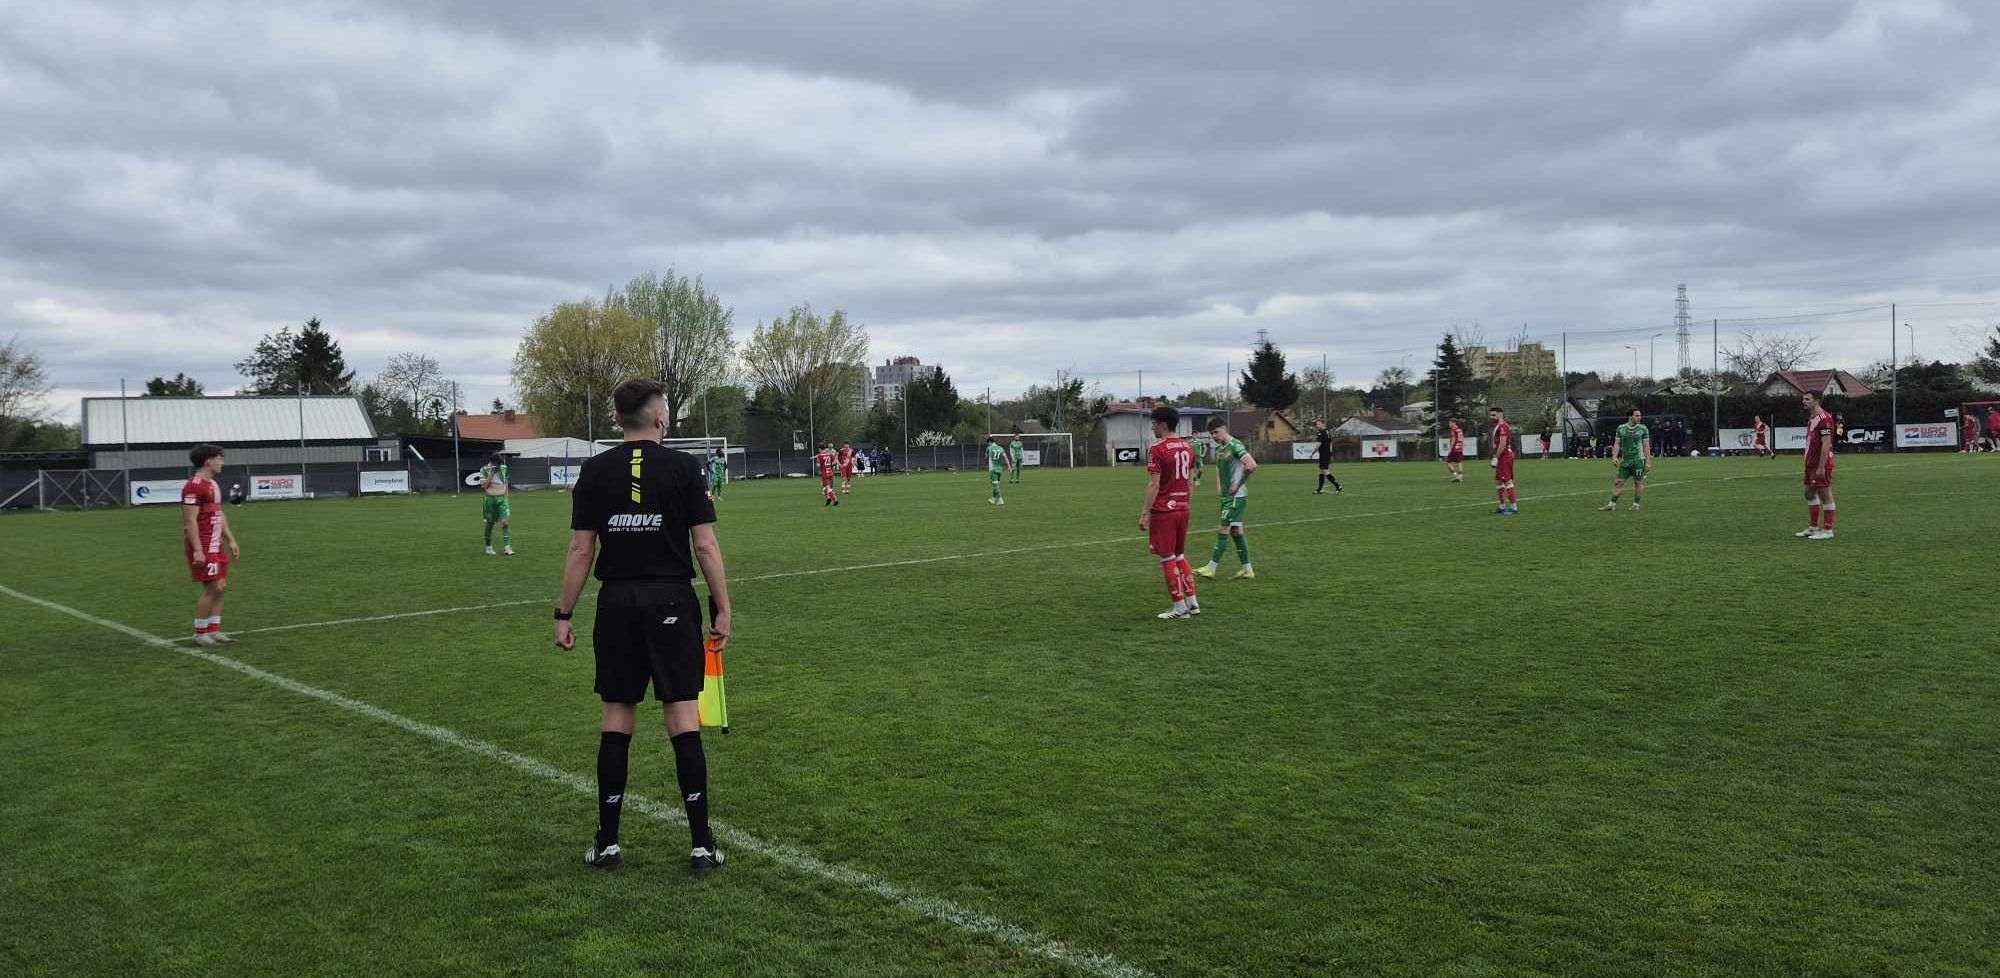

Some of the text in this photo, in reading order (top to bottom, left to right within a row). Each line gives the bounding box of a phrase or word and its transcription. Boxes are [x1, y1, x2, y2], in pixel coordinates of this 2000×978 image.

[1847, 429, 1885, 443] CNF
[1174, 450, 1190, 480] 18
[607, 514, 663, 527] 4MOVE
[207, 562, 219, 576] 21
